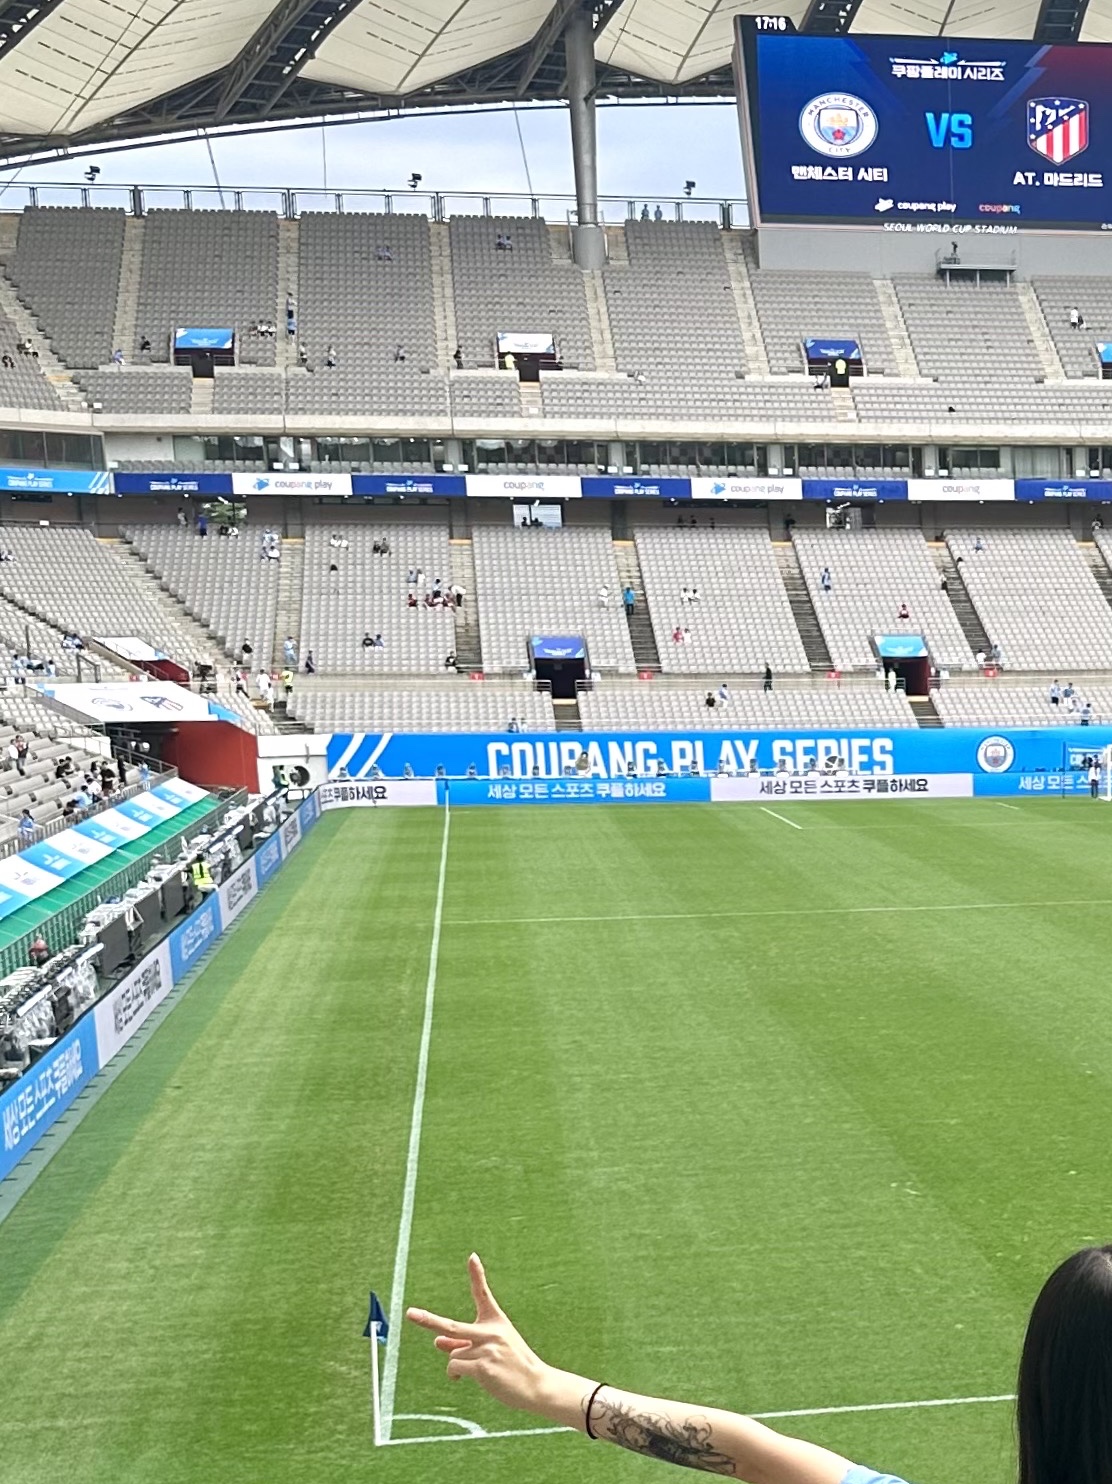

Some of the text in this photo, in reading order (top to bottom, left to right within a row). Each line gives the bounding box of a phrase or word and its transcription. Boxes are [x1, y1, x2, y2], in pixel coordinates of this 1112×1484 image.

[755, 16, 787, 30] 17:16
[964, 66, 1005, 81] 시리즈
[925, 112, 972, 148] VS
[791, 165, 888, 182] 맨체스터 시티
[1013, 171, 1103, 187] AT. 마드리드
[897, 201, 957, 212] coupang play
[979, 204, 1021, 214] coupang
[952, 224, 972, 233] CUP
[314, 480, 332, 490] play
[767, 484, 784, 494] play
[487, 737, 894, 779] COUPANG PLAY SERIES
[759, 778, 929, 795] 세상 모든 스포츠 쿠플하세요
[1018, 775, 1047, 790] 세상
[487, 784, 516, 799] 세상
[519, 784, 549, 799] 모든
[551, 783, 594, 798] 스포츠
